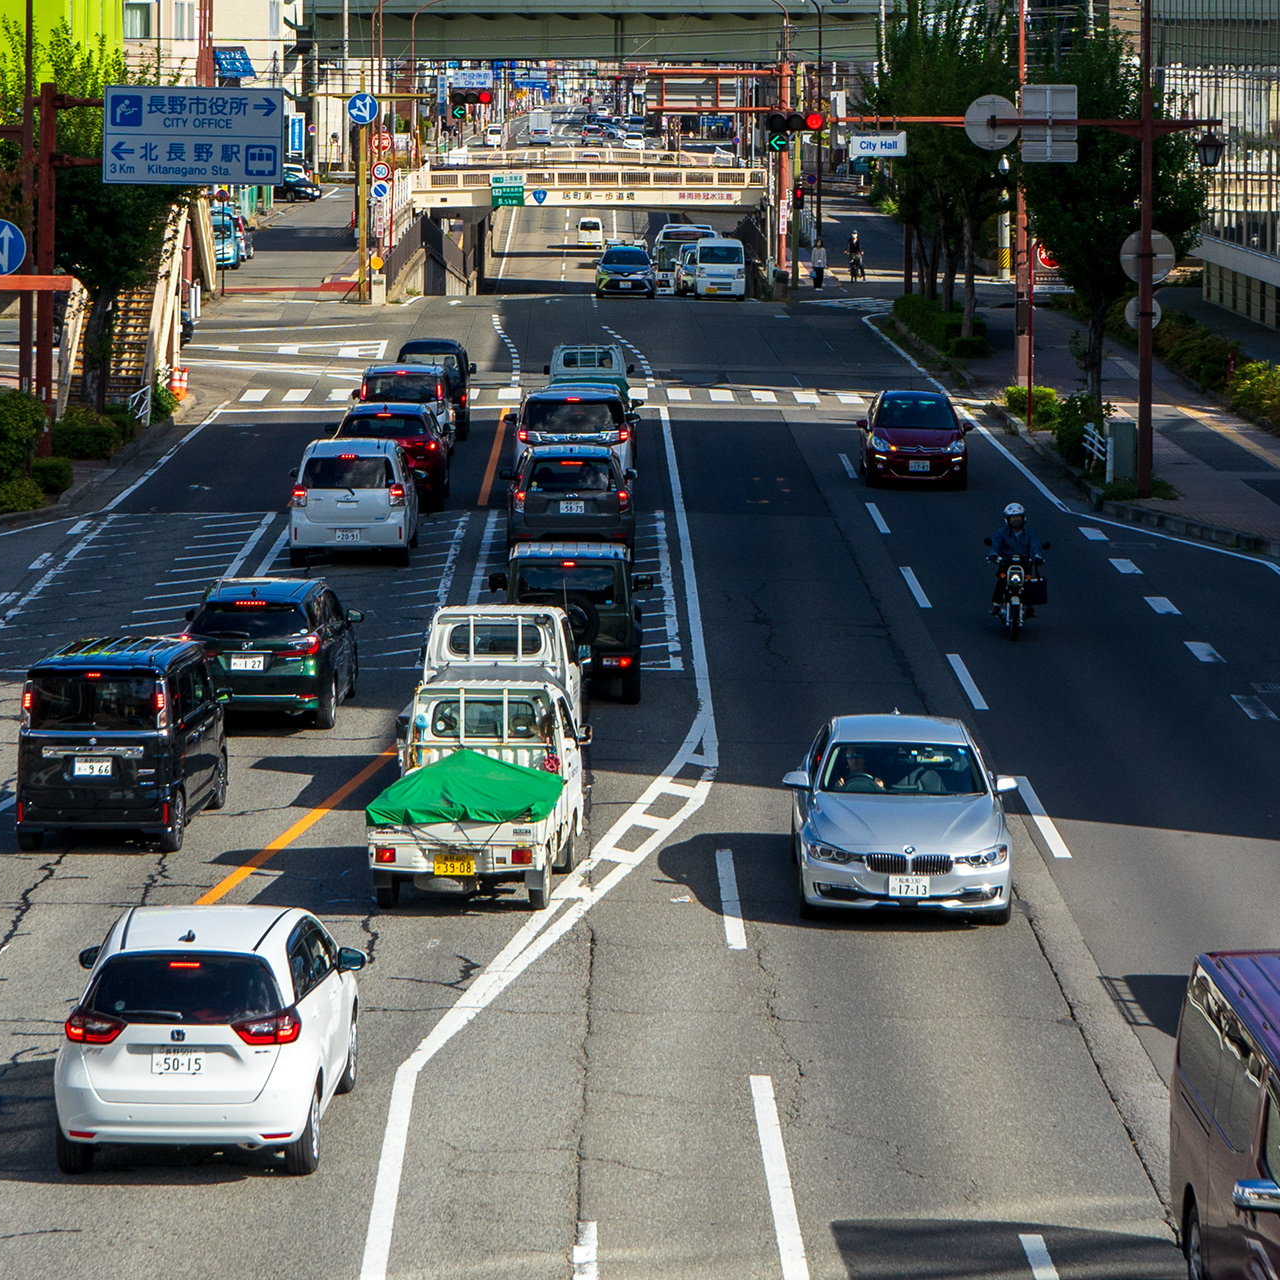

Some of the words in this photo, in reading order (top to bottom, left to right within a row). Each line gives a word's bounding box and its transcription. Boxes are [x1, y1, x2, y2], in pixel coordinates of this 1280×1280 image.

[460, 72, 490, 80] 市役所前
[147, 95, 248, 116] 長野市役所
[163, 117, 188, 128] CITY
[193, 118, 232, 129] OFFICE
[859, 140, 877, 151] City
[880, 140, 897, 149] Hall
[140, 142, 240, 163] 北長野駅
[148, 164, 207, 177] Kitanagano
[212, 165, 231, 176] Sta.
[376, 166, 386, 176] 50
[443, 862, 471, 873] 39-08
[899, 884, 927, 895] 17-13
[163, 1057, 202, 1071] 50-15
